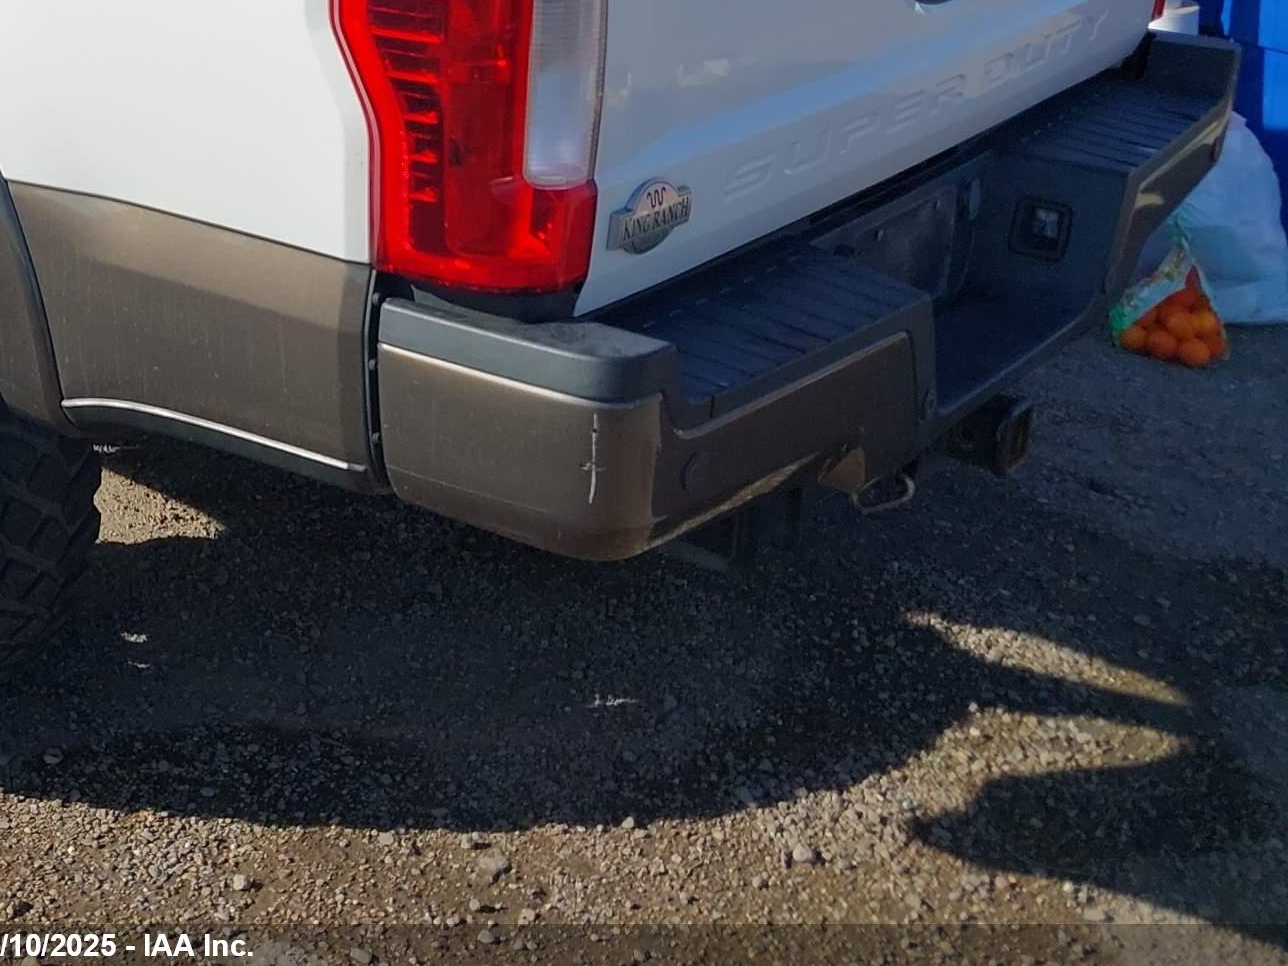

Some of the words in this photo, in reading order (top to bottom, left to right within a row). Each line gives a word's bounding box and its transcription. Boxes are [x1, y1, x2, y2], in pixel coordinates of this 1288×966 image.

[721, 71, 968, 204] SUPER
[981, 9, 1110, 93] DUTY
[623, 213, 650, 242] KING
[652, 195, 689, 231] RANCH
